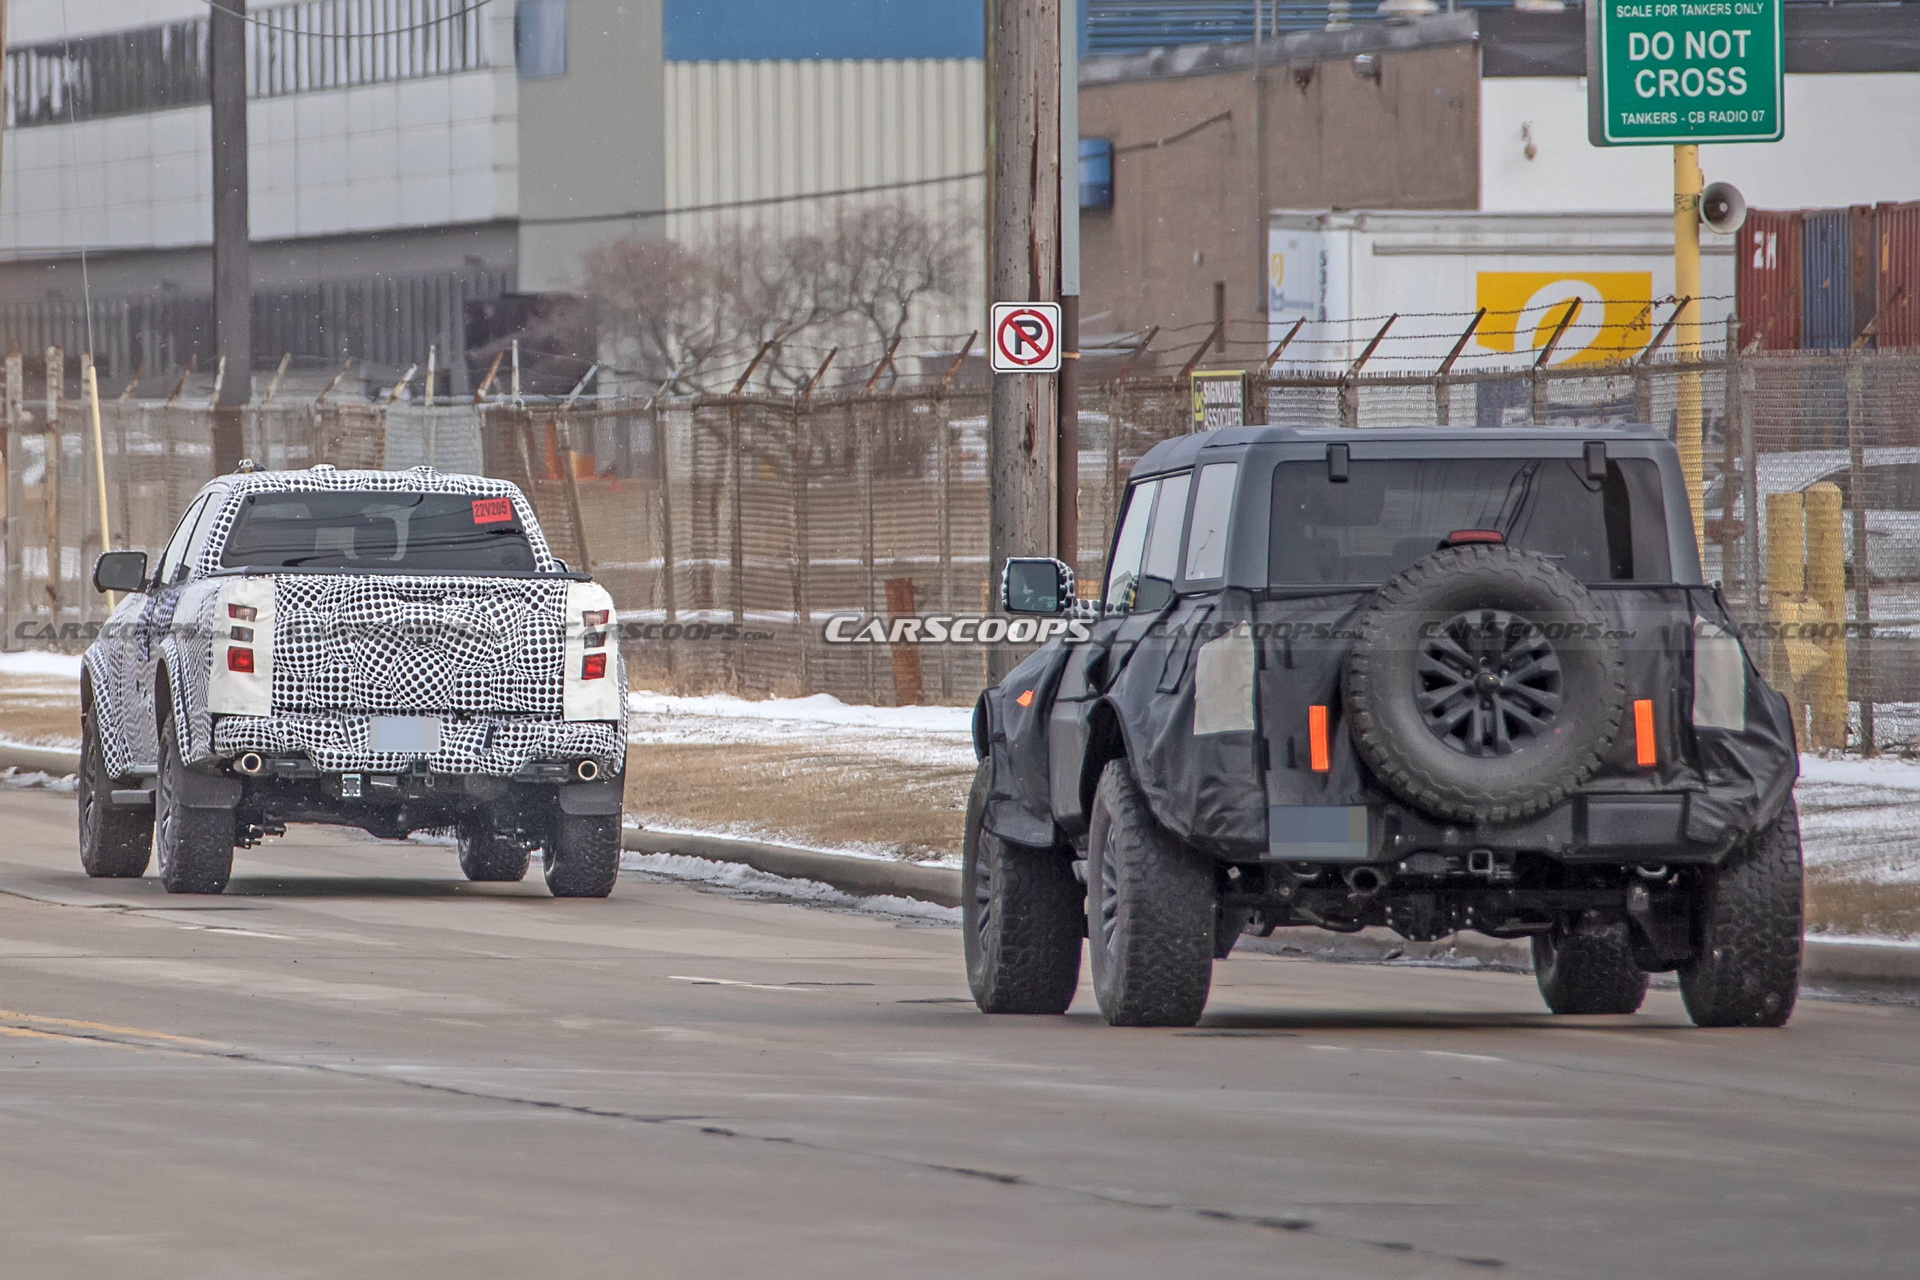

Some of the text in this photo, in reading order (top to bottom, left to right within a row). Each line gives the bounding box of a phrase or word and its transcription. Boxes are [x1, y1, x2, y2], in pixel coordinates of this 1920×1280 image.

[1616, 3, 1764, 18] SCALE FOR TANKERS ONLY
[1629, 29, 1751, 61] DO NOT
[1635, 66, 1747, 98] CROSS
[1621, 112, 1677, 125] TANKERS
[1688, 112, 1705, 123] CB
[1709, 111, 1748, 122] RADIO
[1752, 110, 1765, 122] 07
[1203, 380, 1242, 404] SIGNATURE
[474, 501, 508, 517] 22V205
